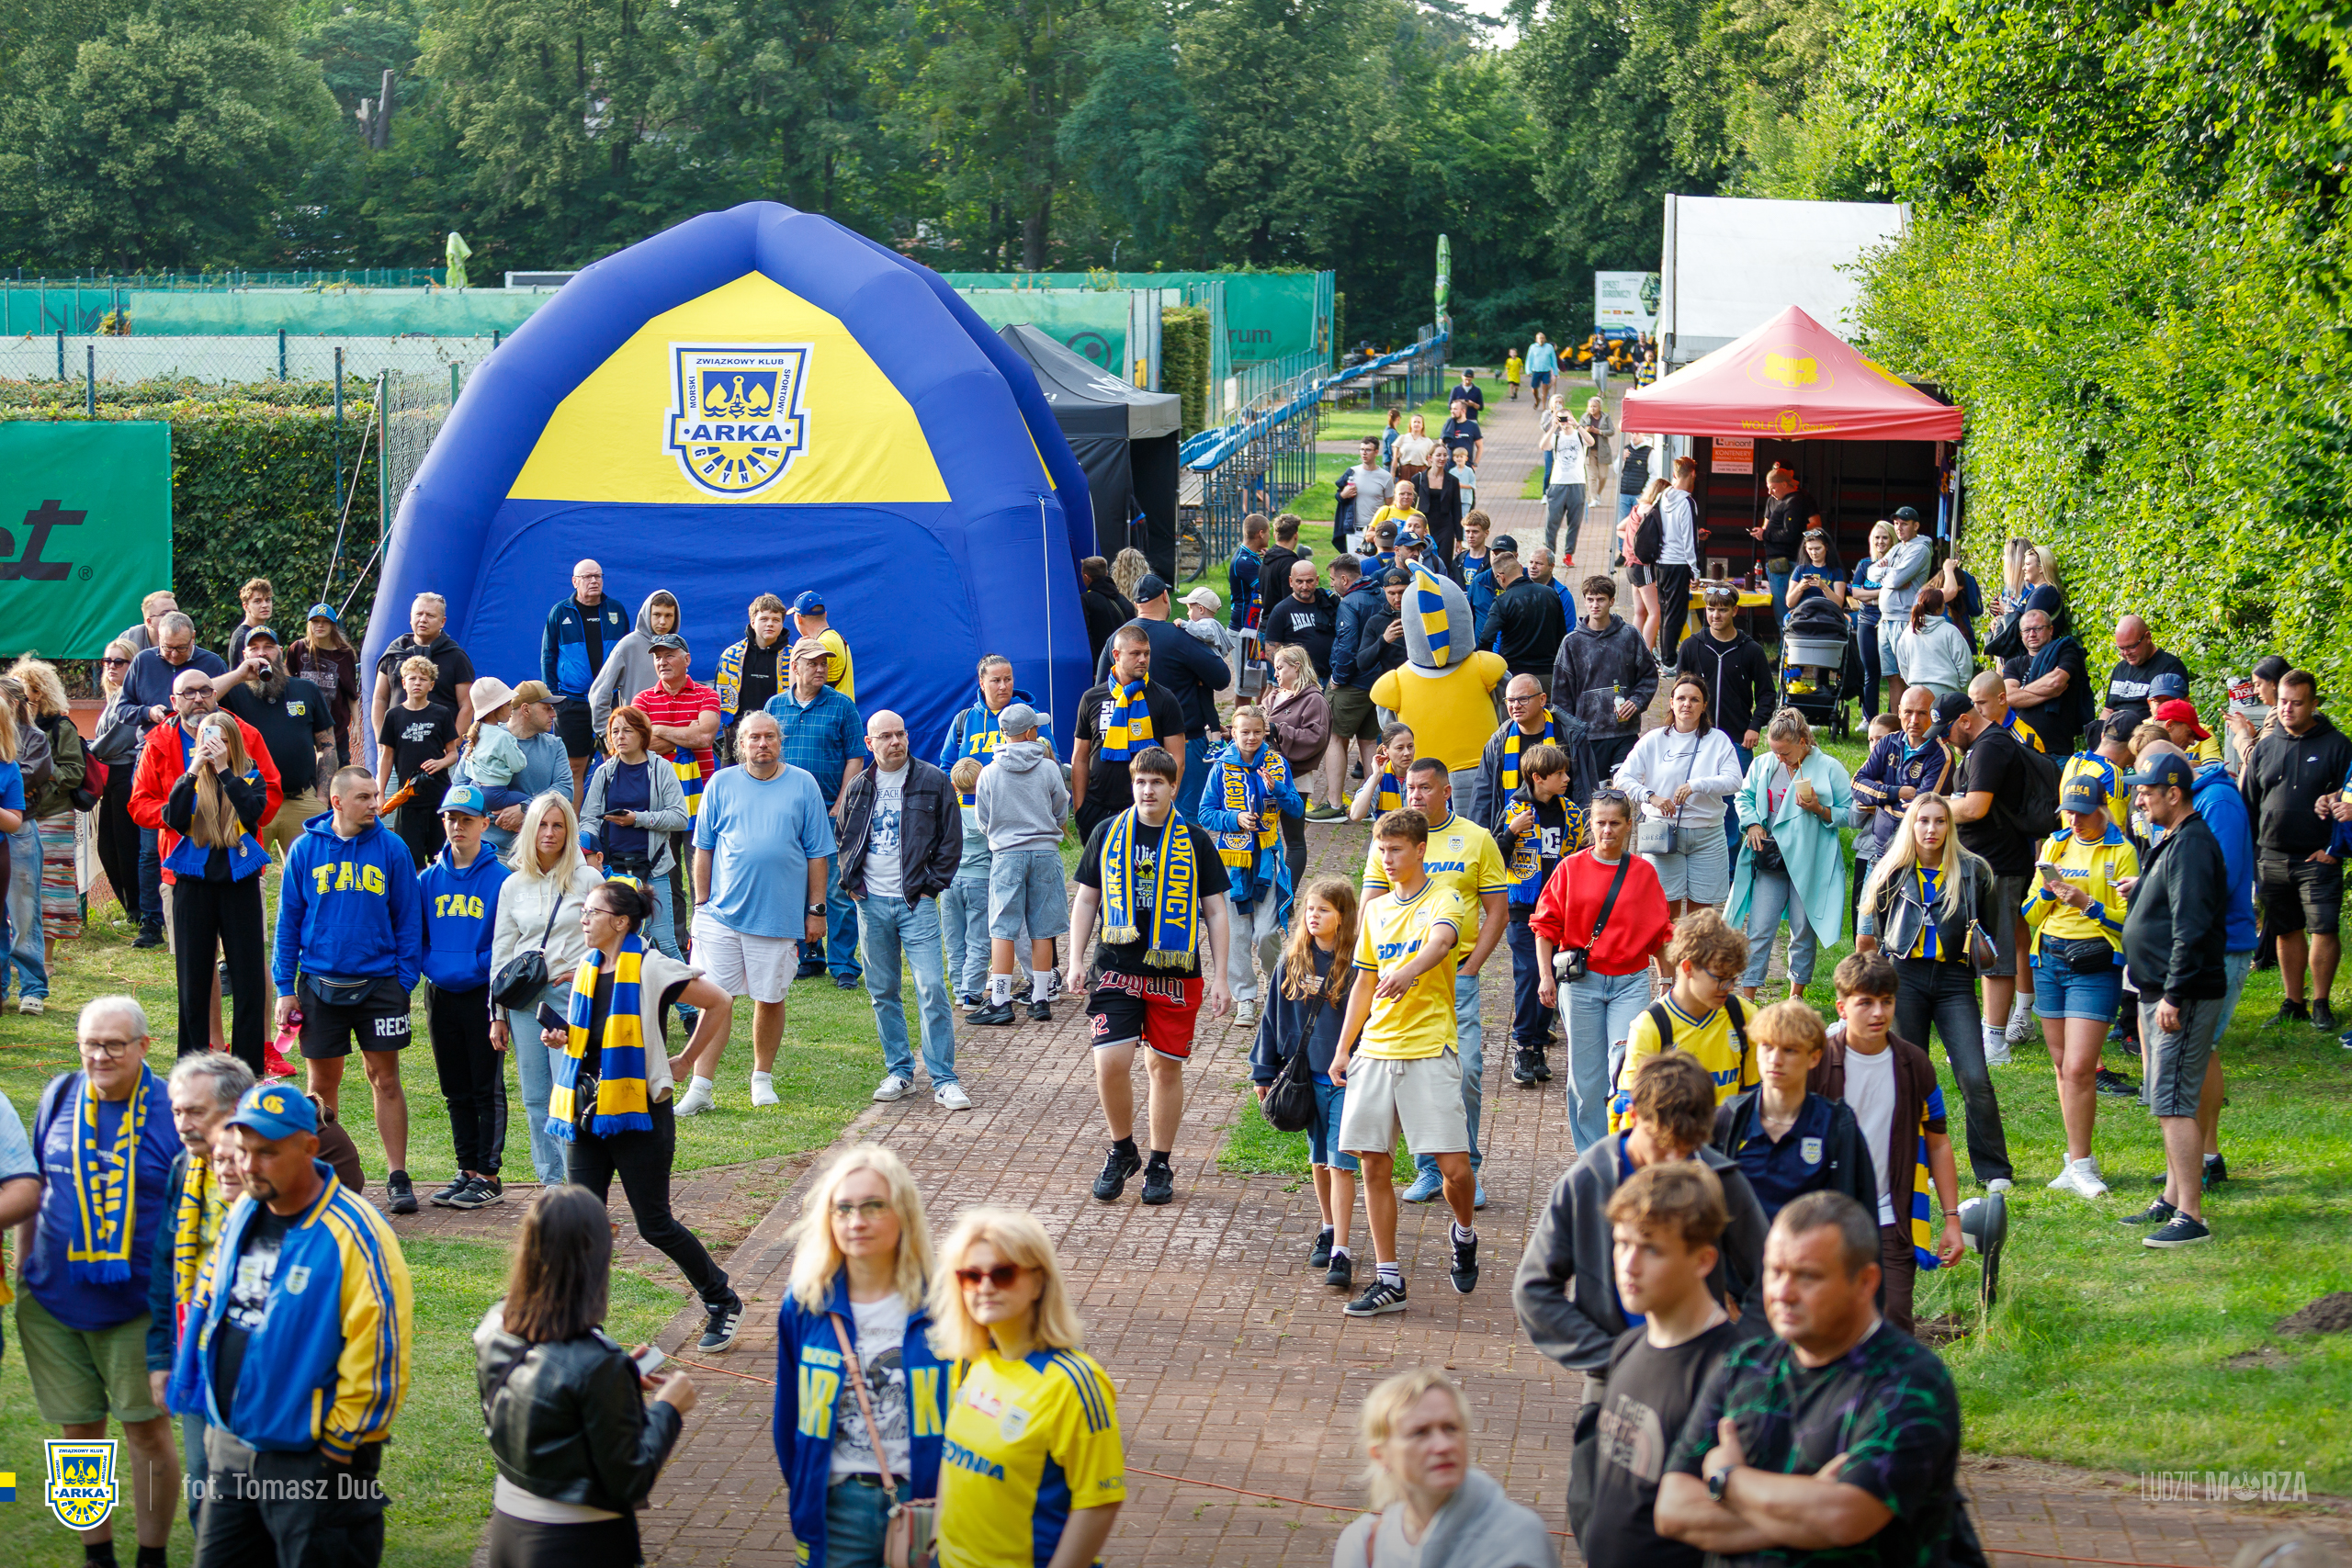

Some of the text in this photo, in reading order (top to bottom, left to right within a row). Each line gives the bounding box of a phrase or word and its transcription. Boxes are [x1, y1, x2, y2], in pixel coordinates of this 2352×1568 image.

[695, 358, 755, 367] ZWIĄZKOWY
[688, 376, 697, 409] MORSKI
[776, 368, 791, 415] SPORTOWY
[690, 424, 783, 441] ARKA
[1741, 419, 1774, 431] WOLF
[694, 448, 780, 483] GDYNIA
[2233, 687, 2255, 699] TYSK
[2063, 785, 2090, 797] ARKA
[311, 862, 386, 896] TAG
[1106, 854, 1124, 911] ARKA
[1165, 824, 1193, 931] ARKOWCY
[435, 894, 485, 919] TAG
[1615, 1393, 1651, 1427] THE
